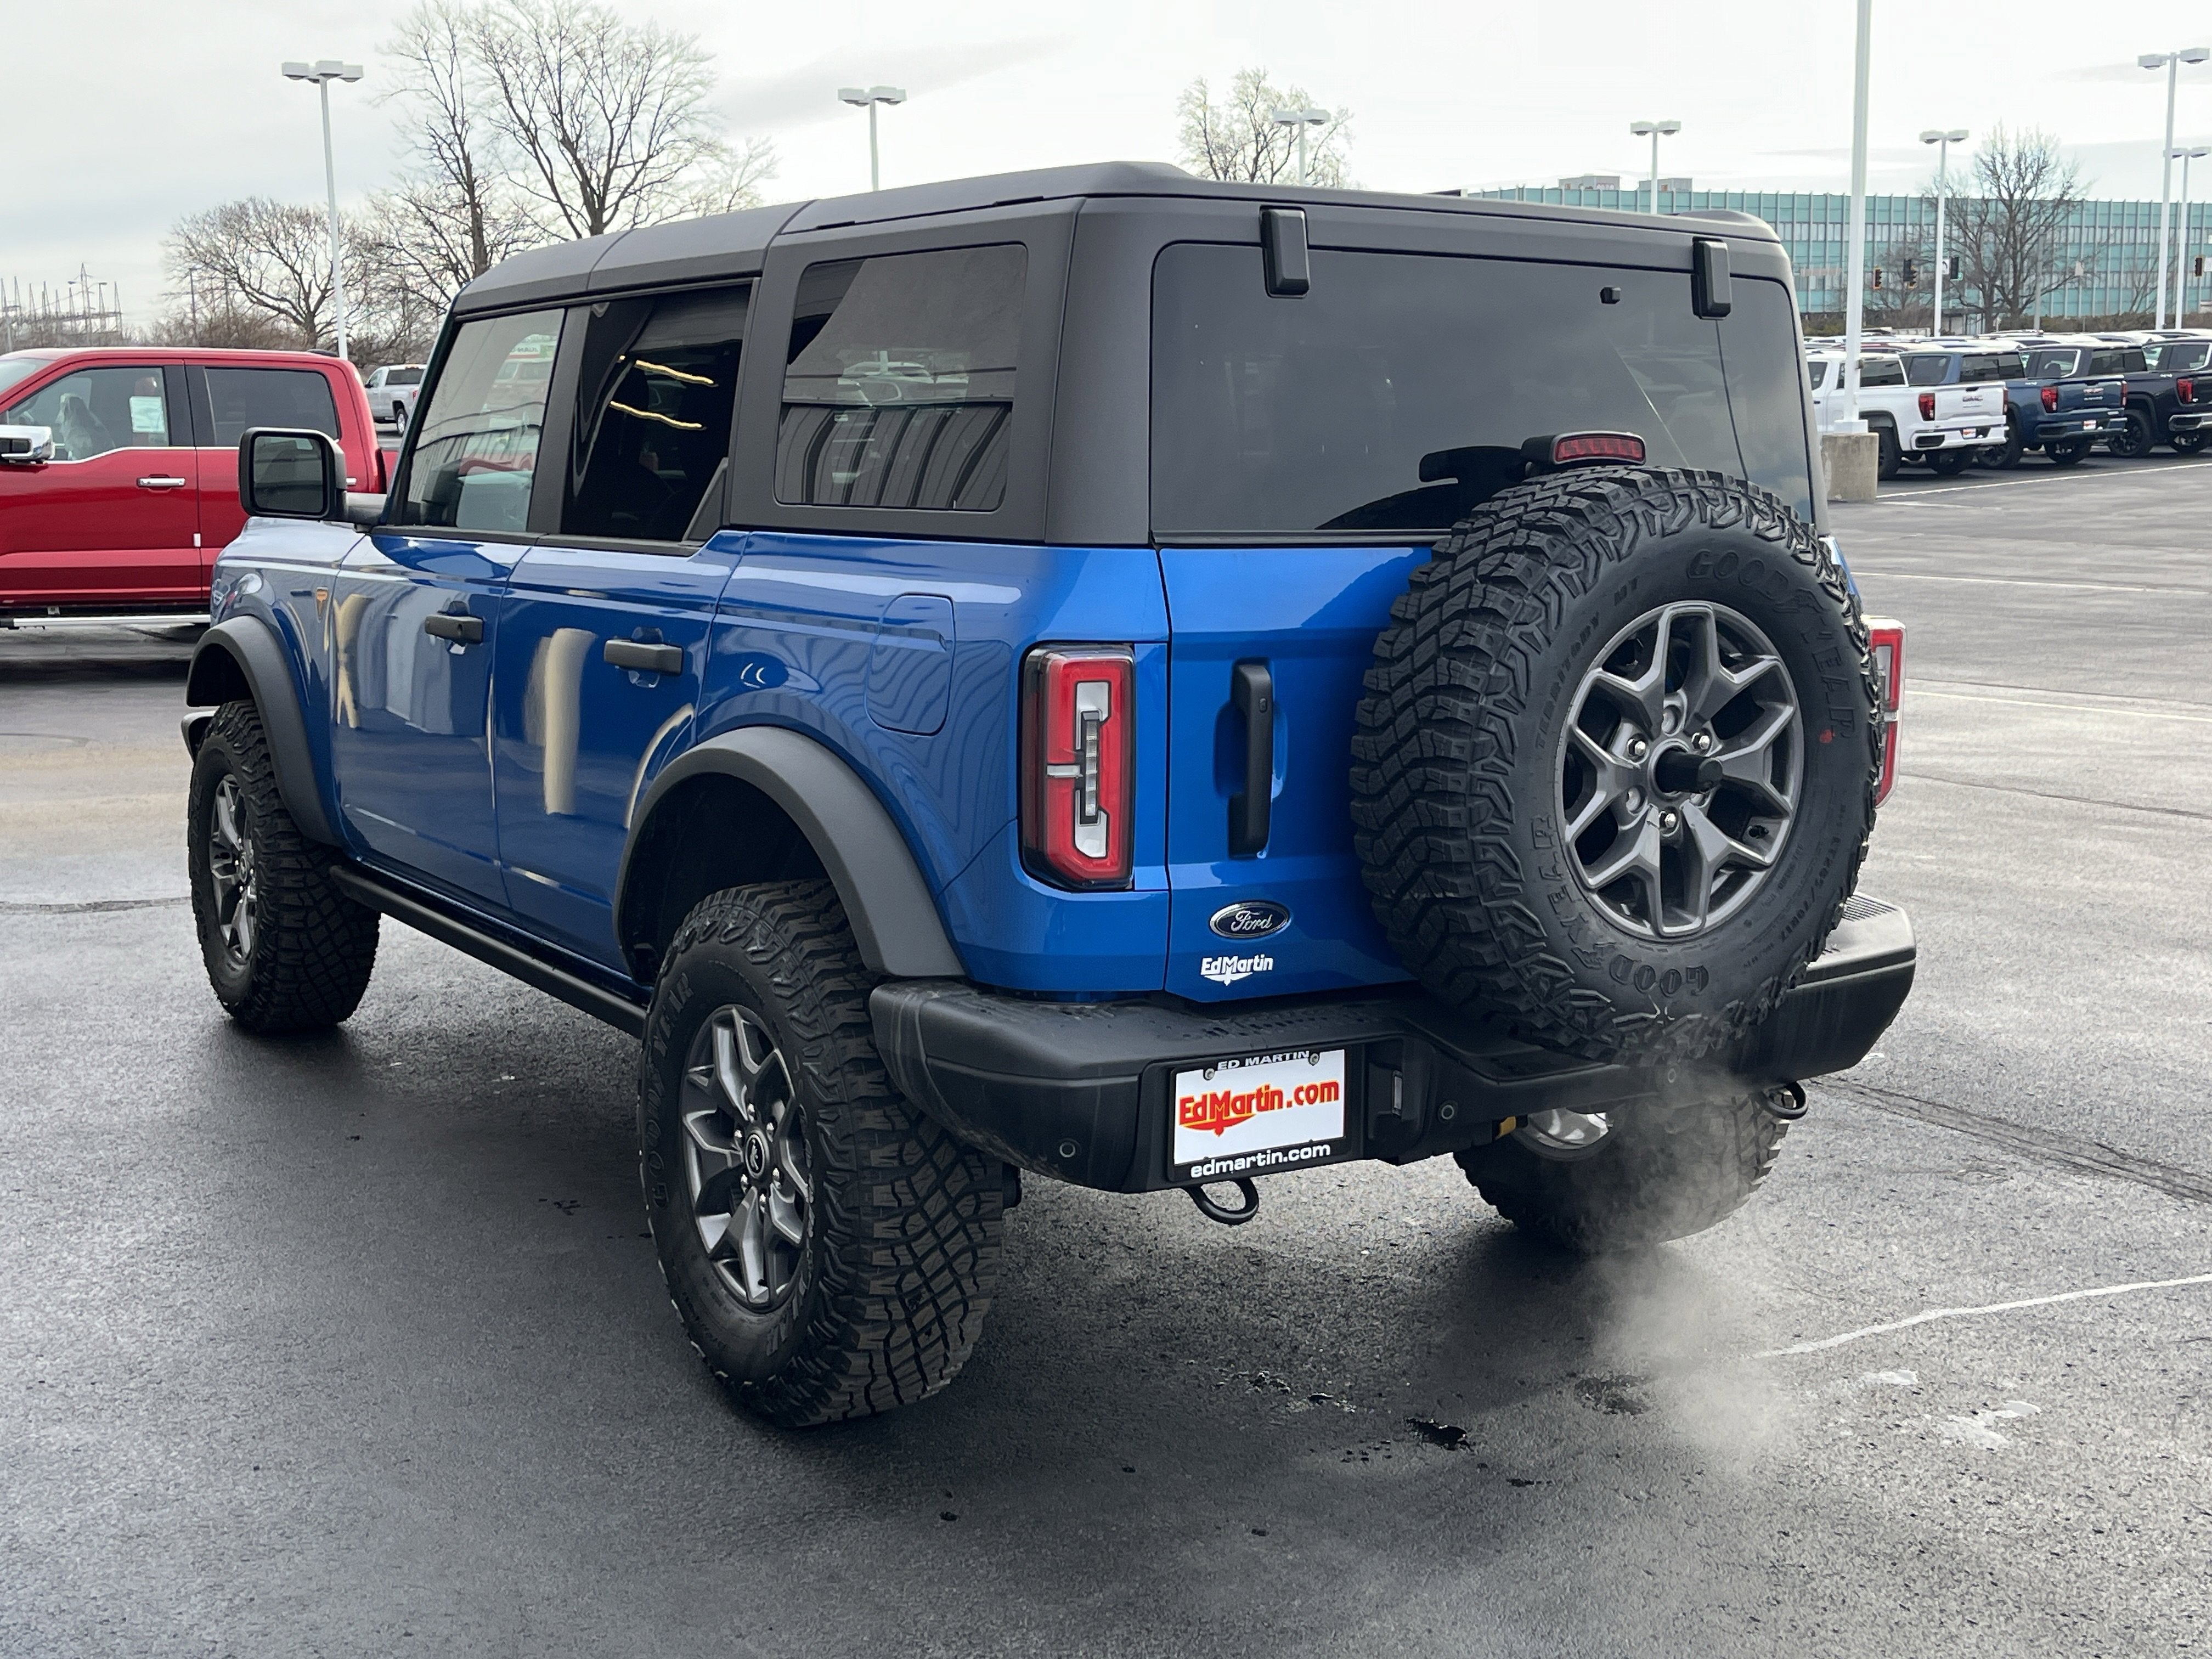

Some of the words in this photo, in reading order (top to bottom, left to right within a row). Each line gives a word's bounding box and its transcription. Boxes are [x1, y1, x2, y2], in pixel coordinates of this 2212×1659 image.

[1231, 910, 1273, 932] Ford
[1217, 1059, 1240, 1070] ED
[1245, 1050, 1310, 1067] MARTIN
[1190, 1143, 1331, 1178] edmartin.com
